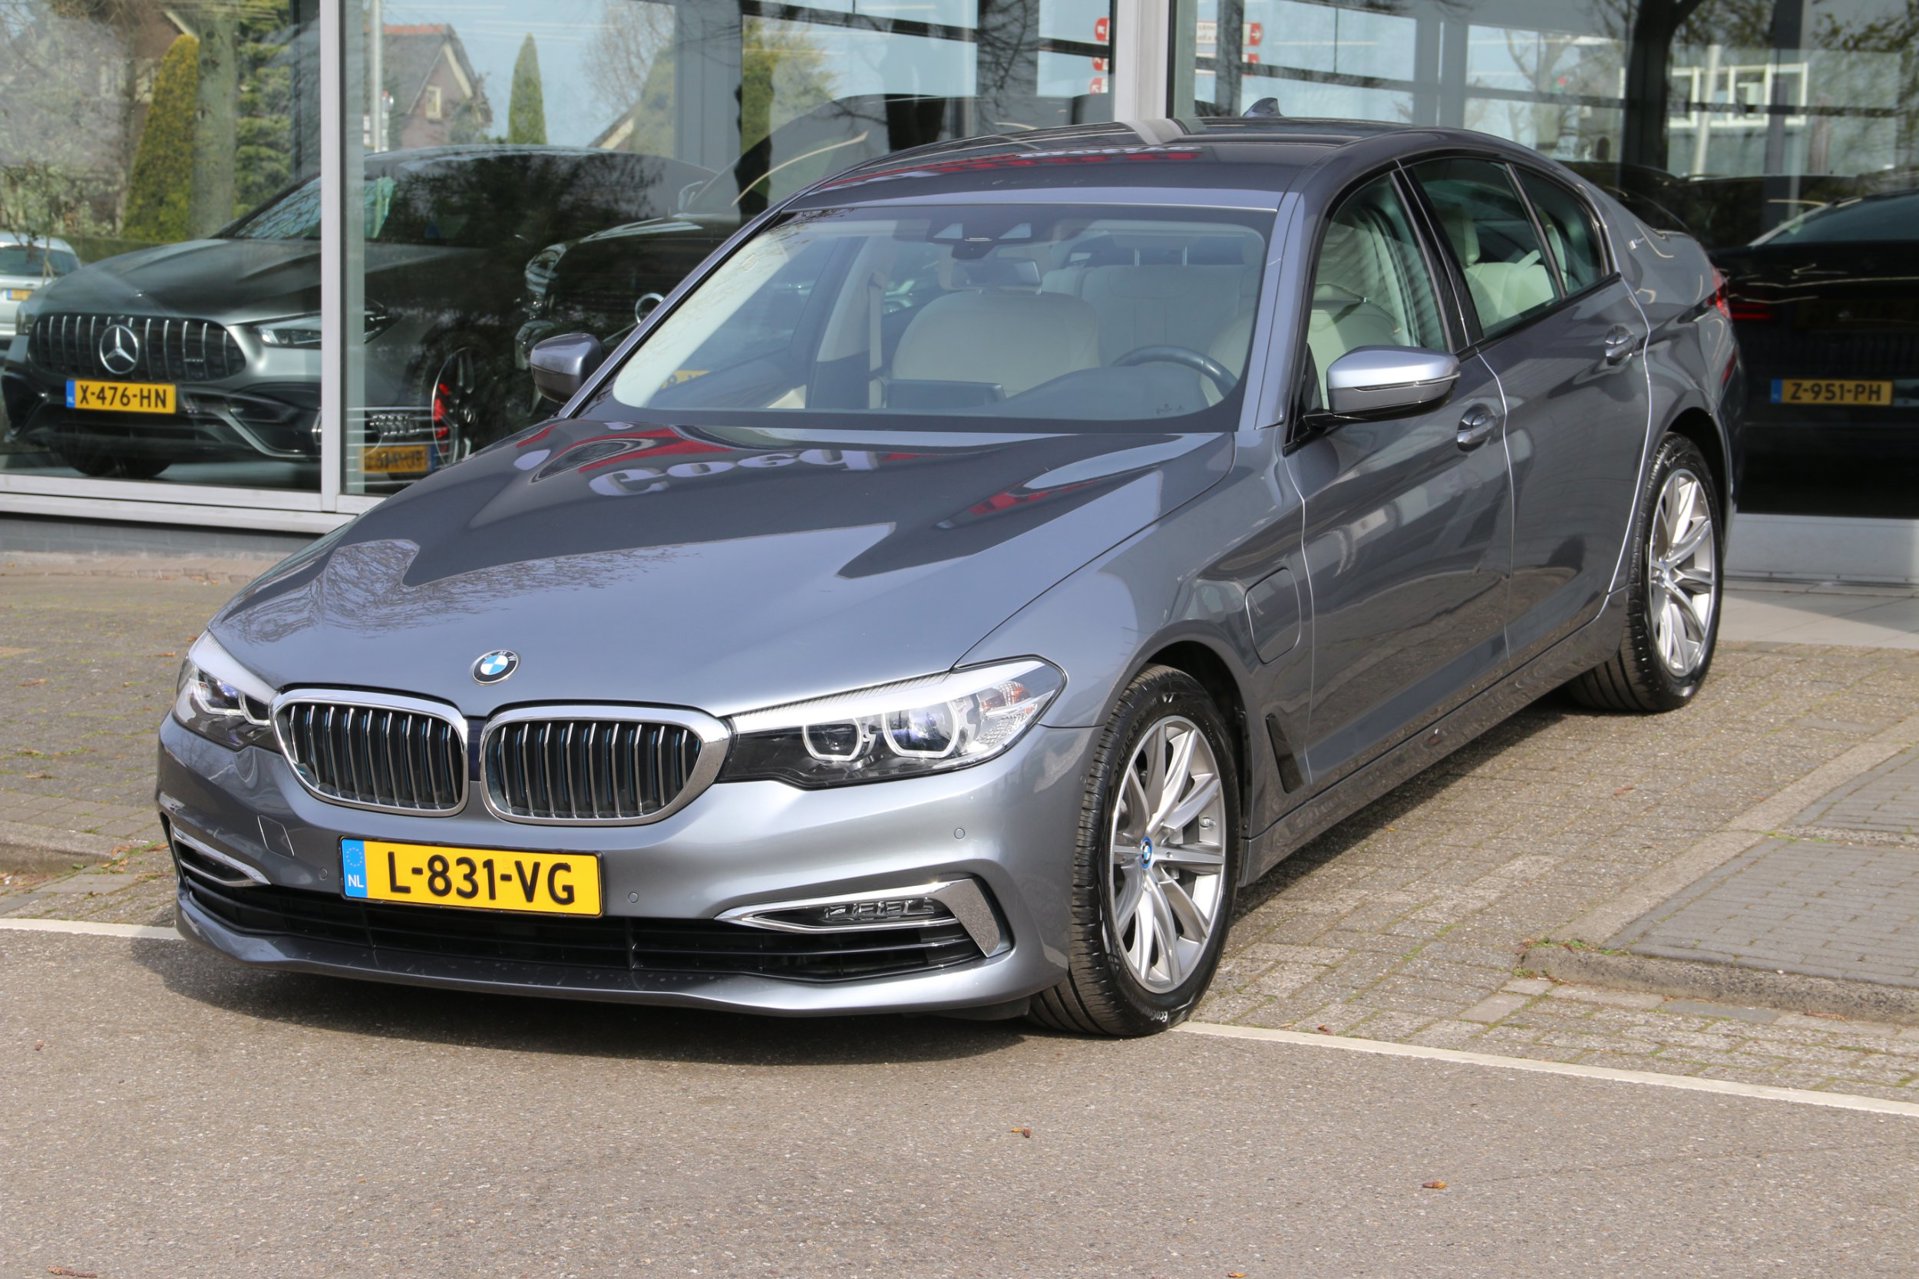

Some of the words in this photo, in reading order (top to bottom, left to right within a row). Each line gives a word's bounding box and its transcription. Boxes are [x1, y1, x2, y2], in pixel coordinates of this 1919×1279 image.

[79, 385, 167, 408] X-476-HN
[1790, 382, 1882, 402] Z-951-PH
[347, 874, 364, 888] NL
[387, 851, 575, 905] L-831-VG
